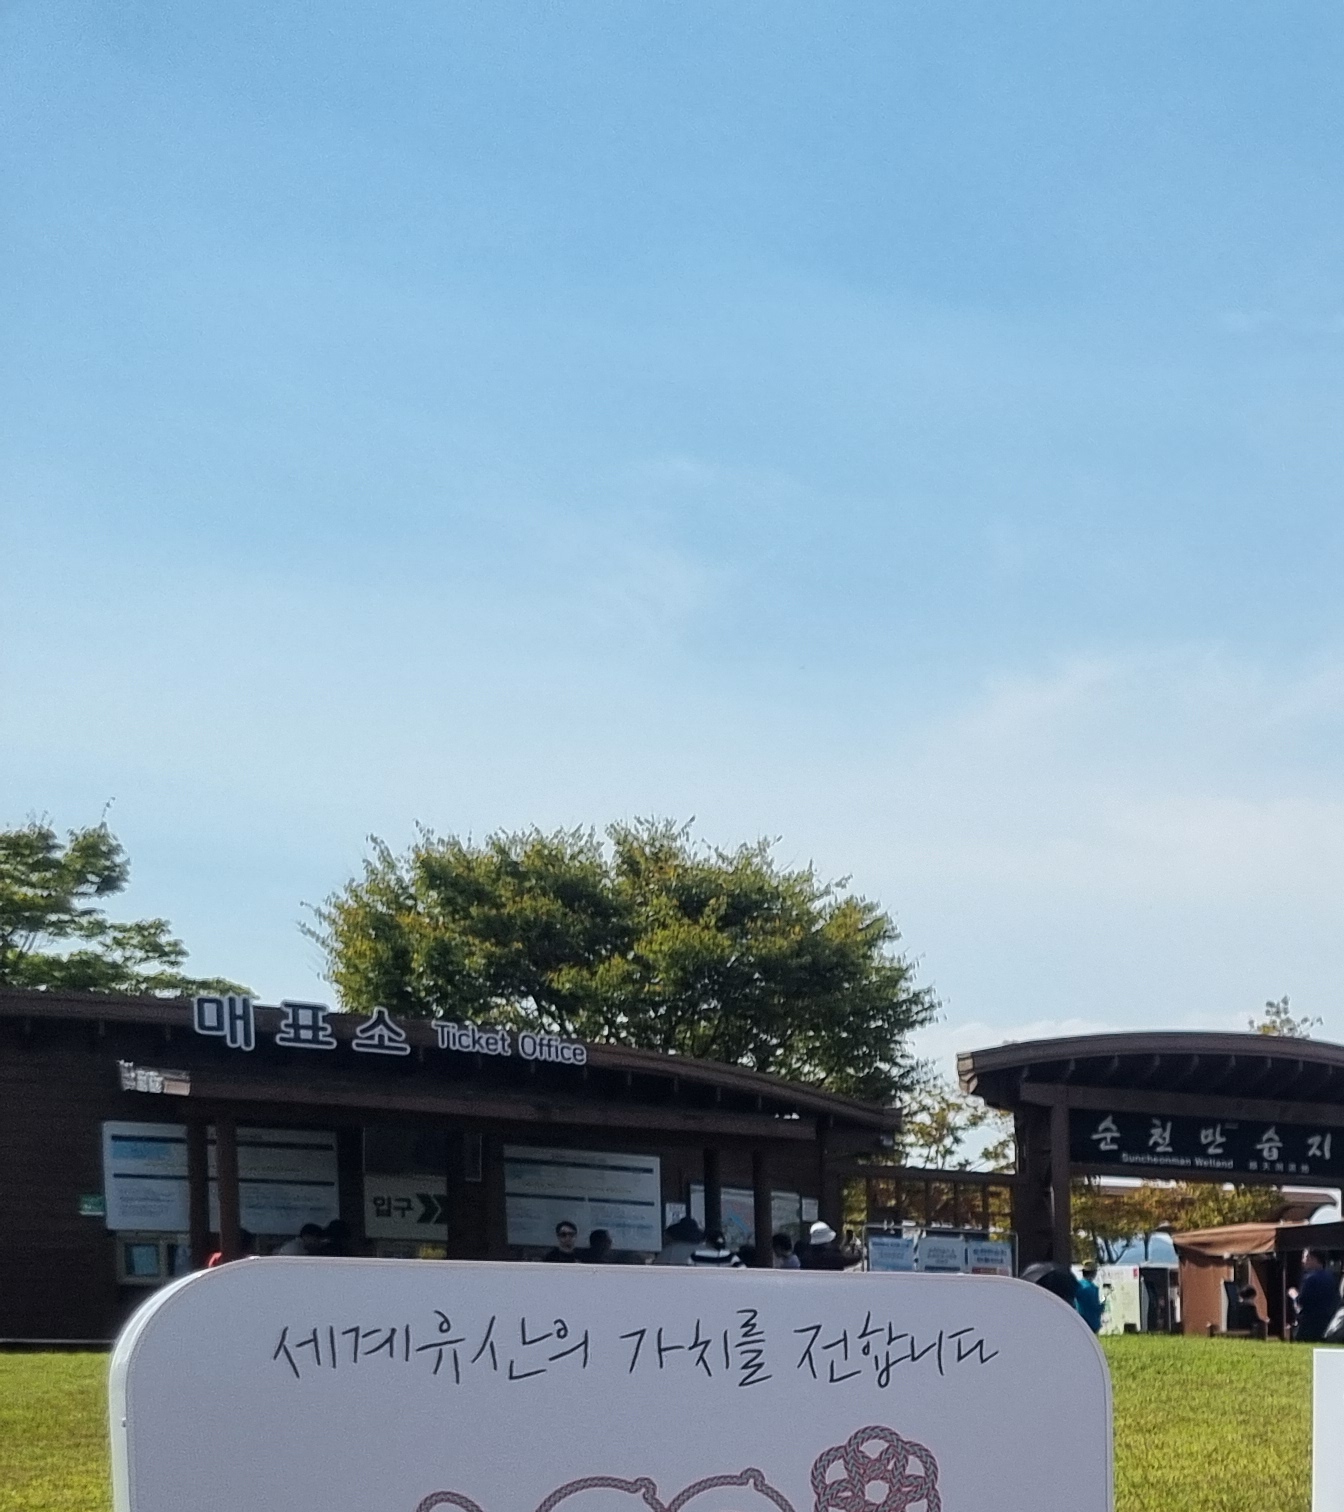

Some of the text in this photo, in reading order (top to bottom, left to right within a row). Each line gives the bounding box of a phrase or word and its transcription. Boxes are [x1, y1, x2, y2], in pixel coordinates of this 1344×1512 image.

[431, 1020, 588, 1065] Ticket Office
[373, 1195, 414, 1218] 입구
[272, 1308, 999, 1389] 세계유산의 가치를 전합니다
